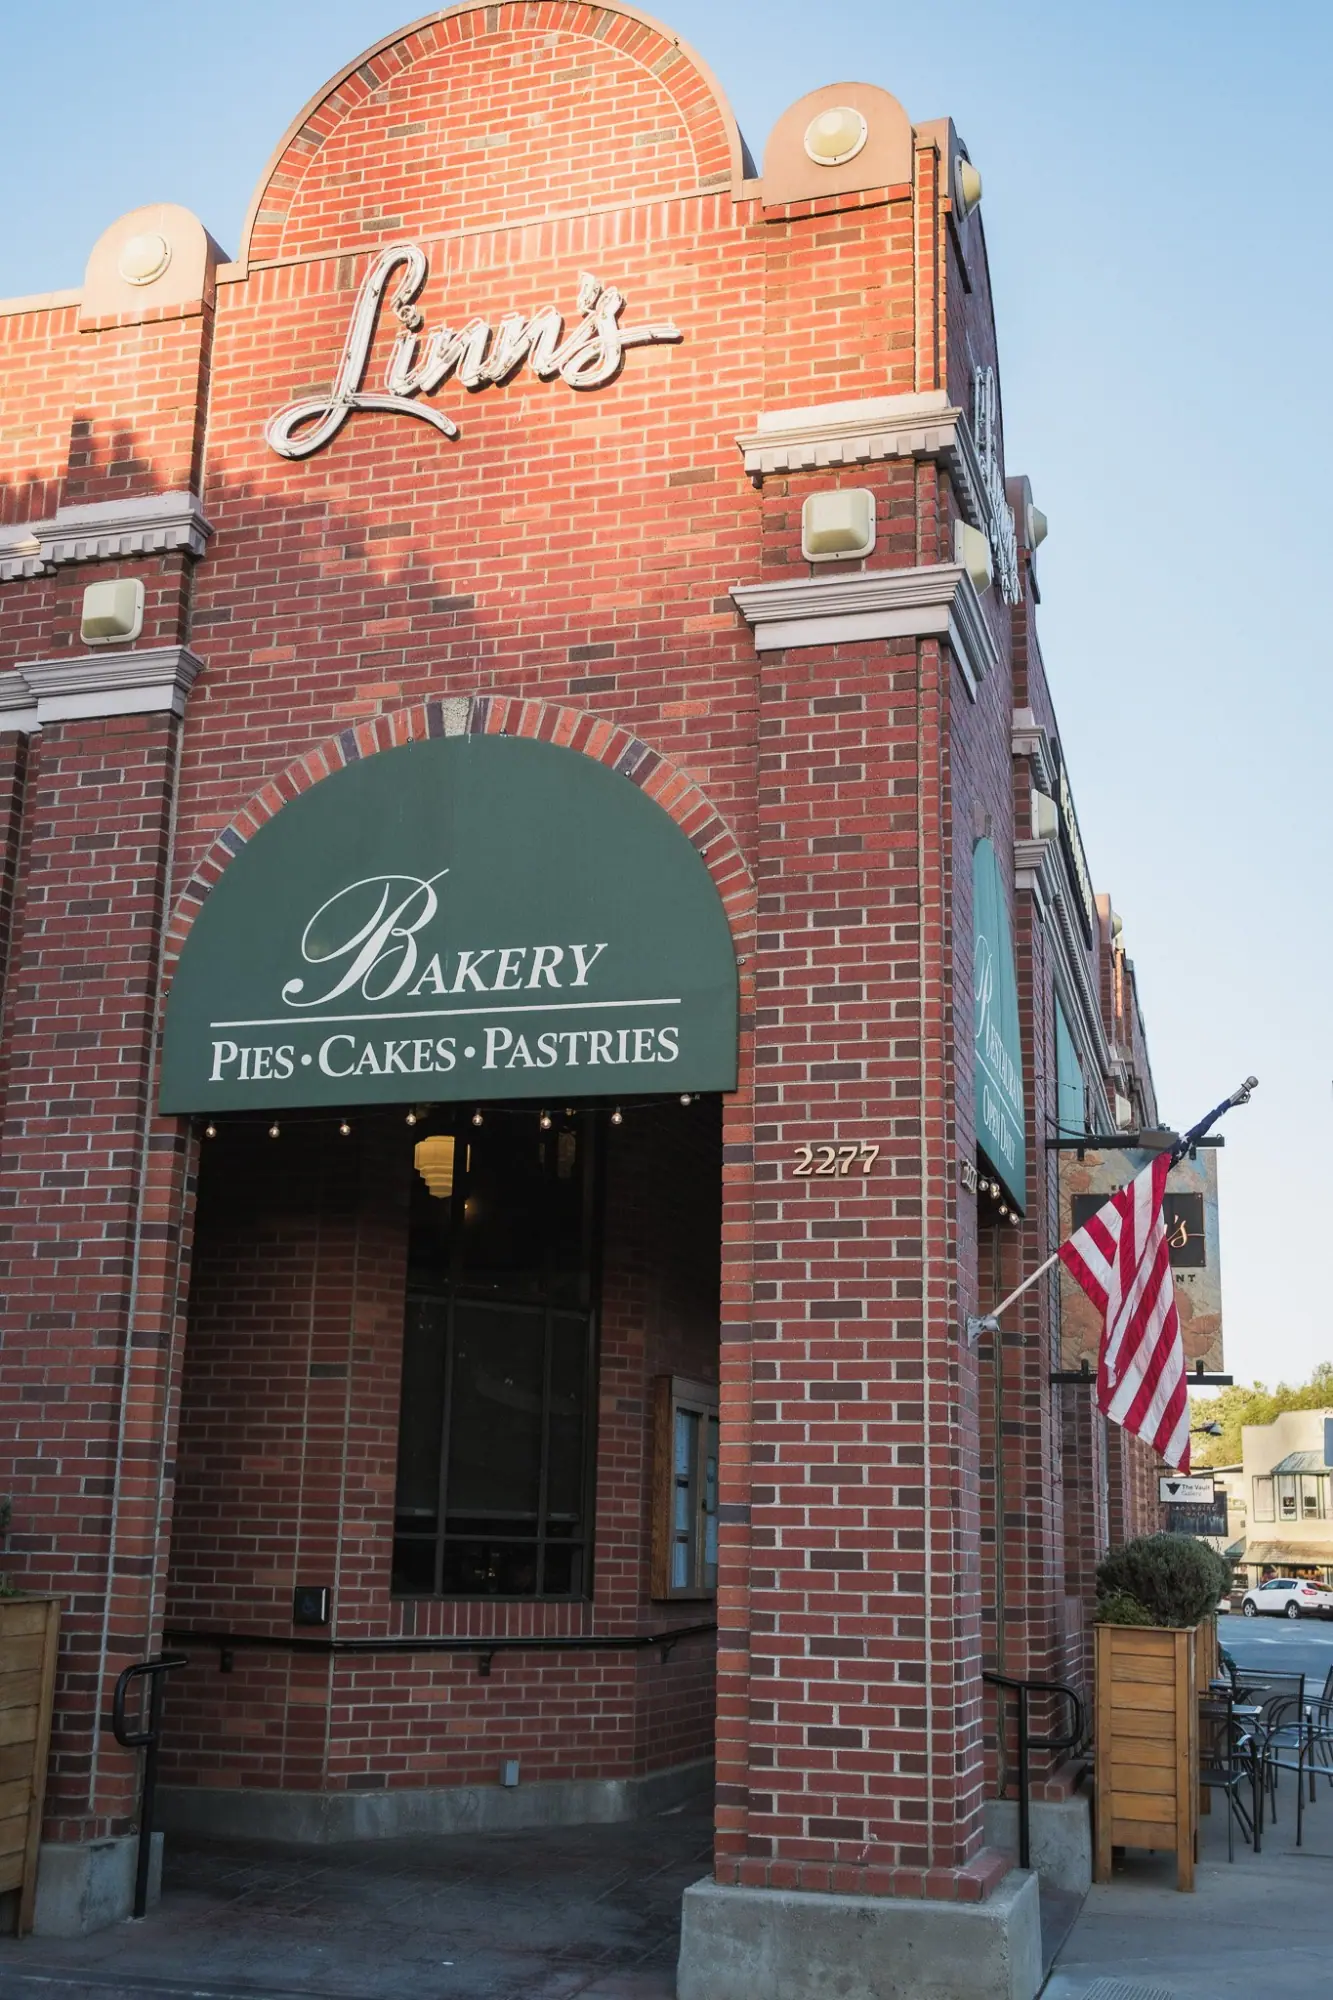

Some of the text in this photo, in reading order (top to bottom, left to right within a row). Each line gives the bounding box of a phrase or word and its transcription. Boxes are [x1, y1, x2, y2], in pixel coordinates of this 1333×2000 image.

[264, 241, 682, 458] Linn's
[281, 868, 608, 1007] BAKERY
[208, 1026, 680, 1081] PIES CAKES PASTRIES
[792, 1144, 880, 1176] 2277
[1195, 1483, 1211, 1491] Vault
